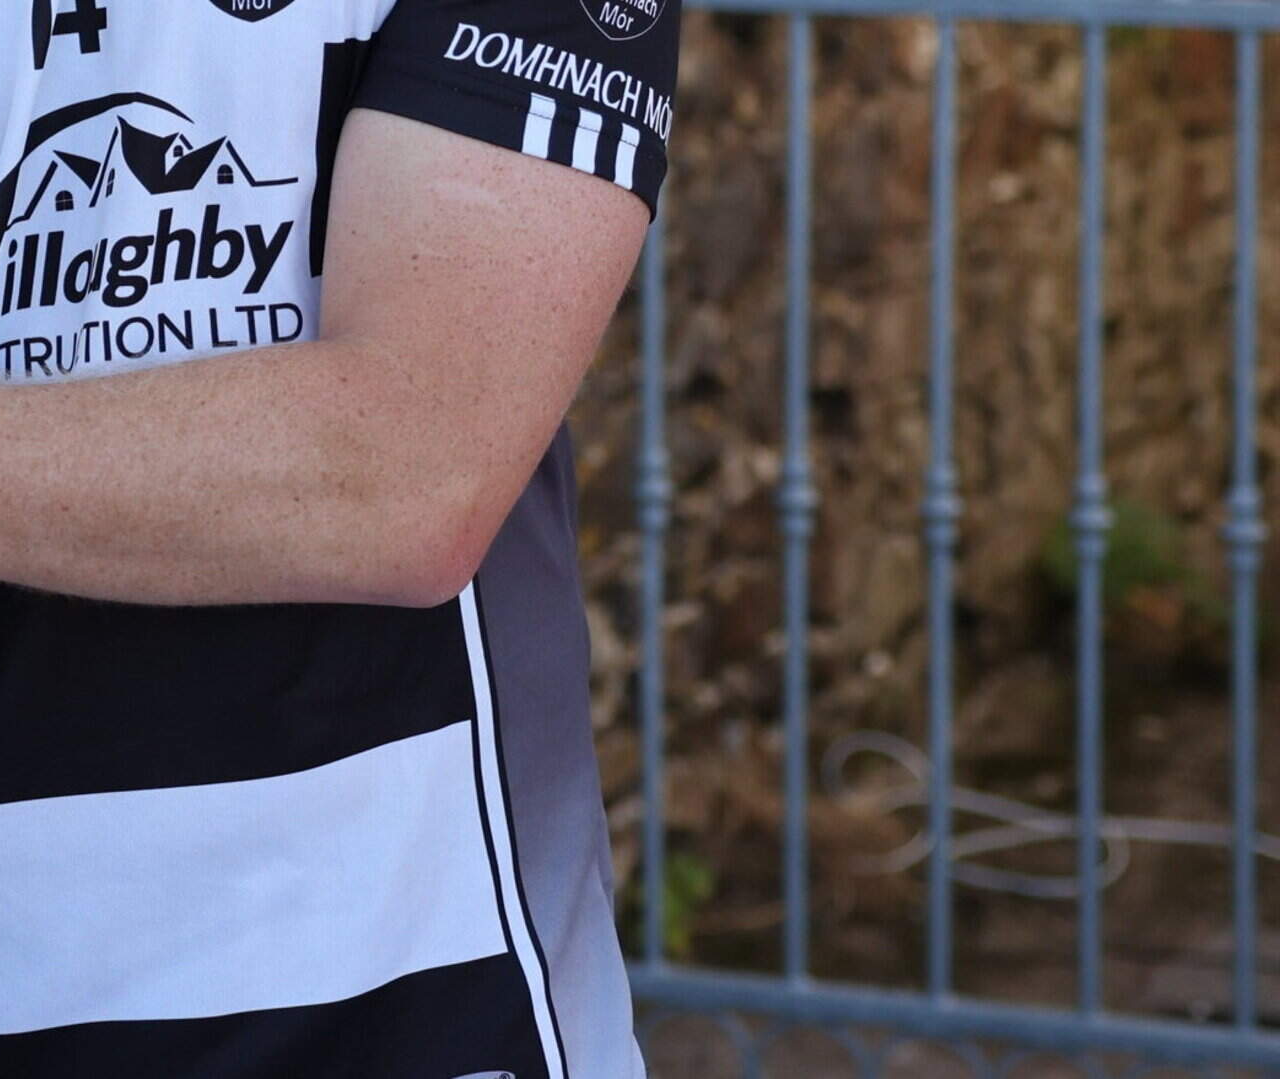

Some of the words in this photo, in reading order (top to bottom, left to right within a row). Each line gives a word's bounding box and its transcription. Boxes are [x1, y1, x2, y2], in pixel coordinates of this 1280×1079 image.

[599, 1, 635, 32] Mór
[444, 22, 642, 118] DOMHNACH
[208, 301, 304, 348] LTD
